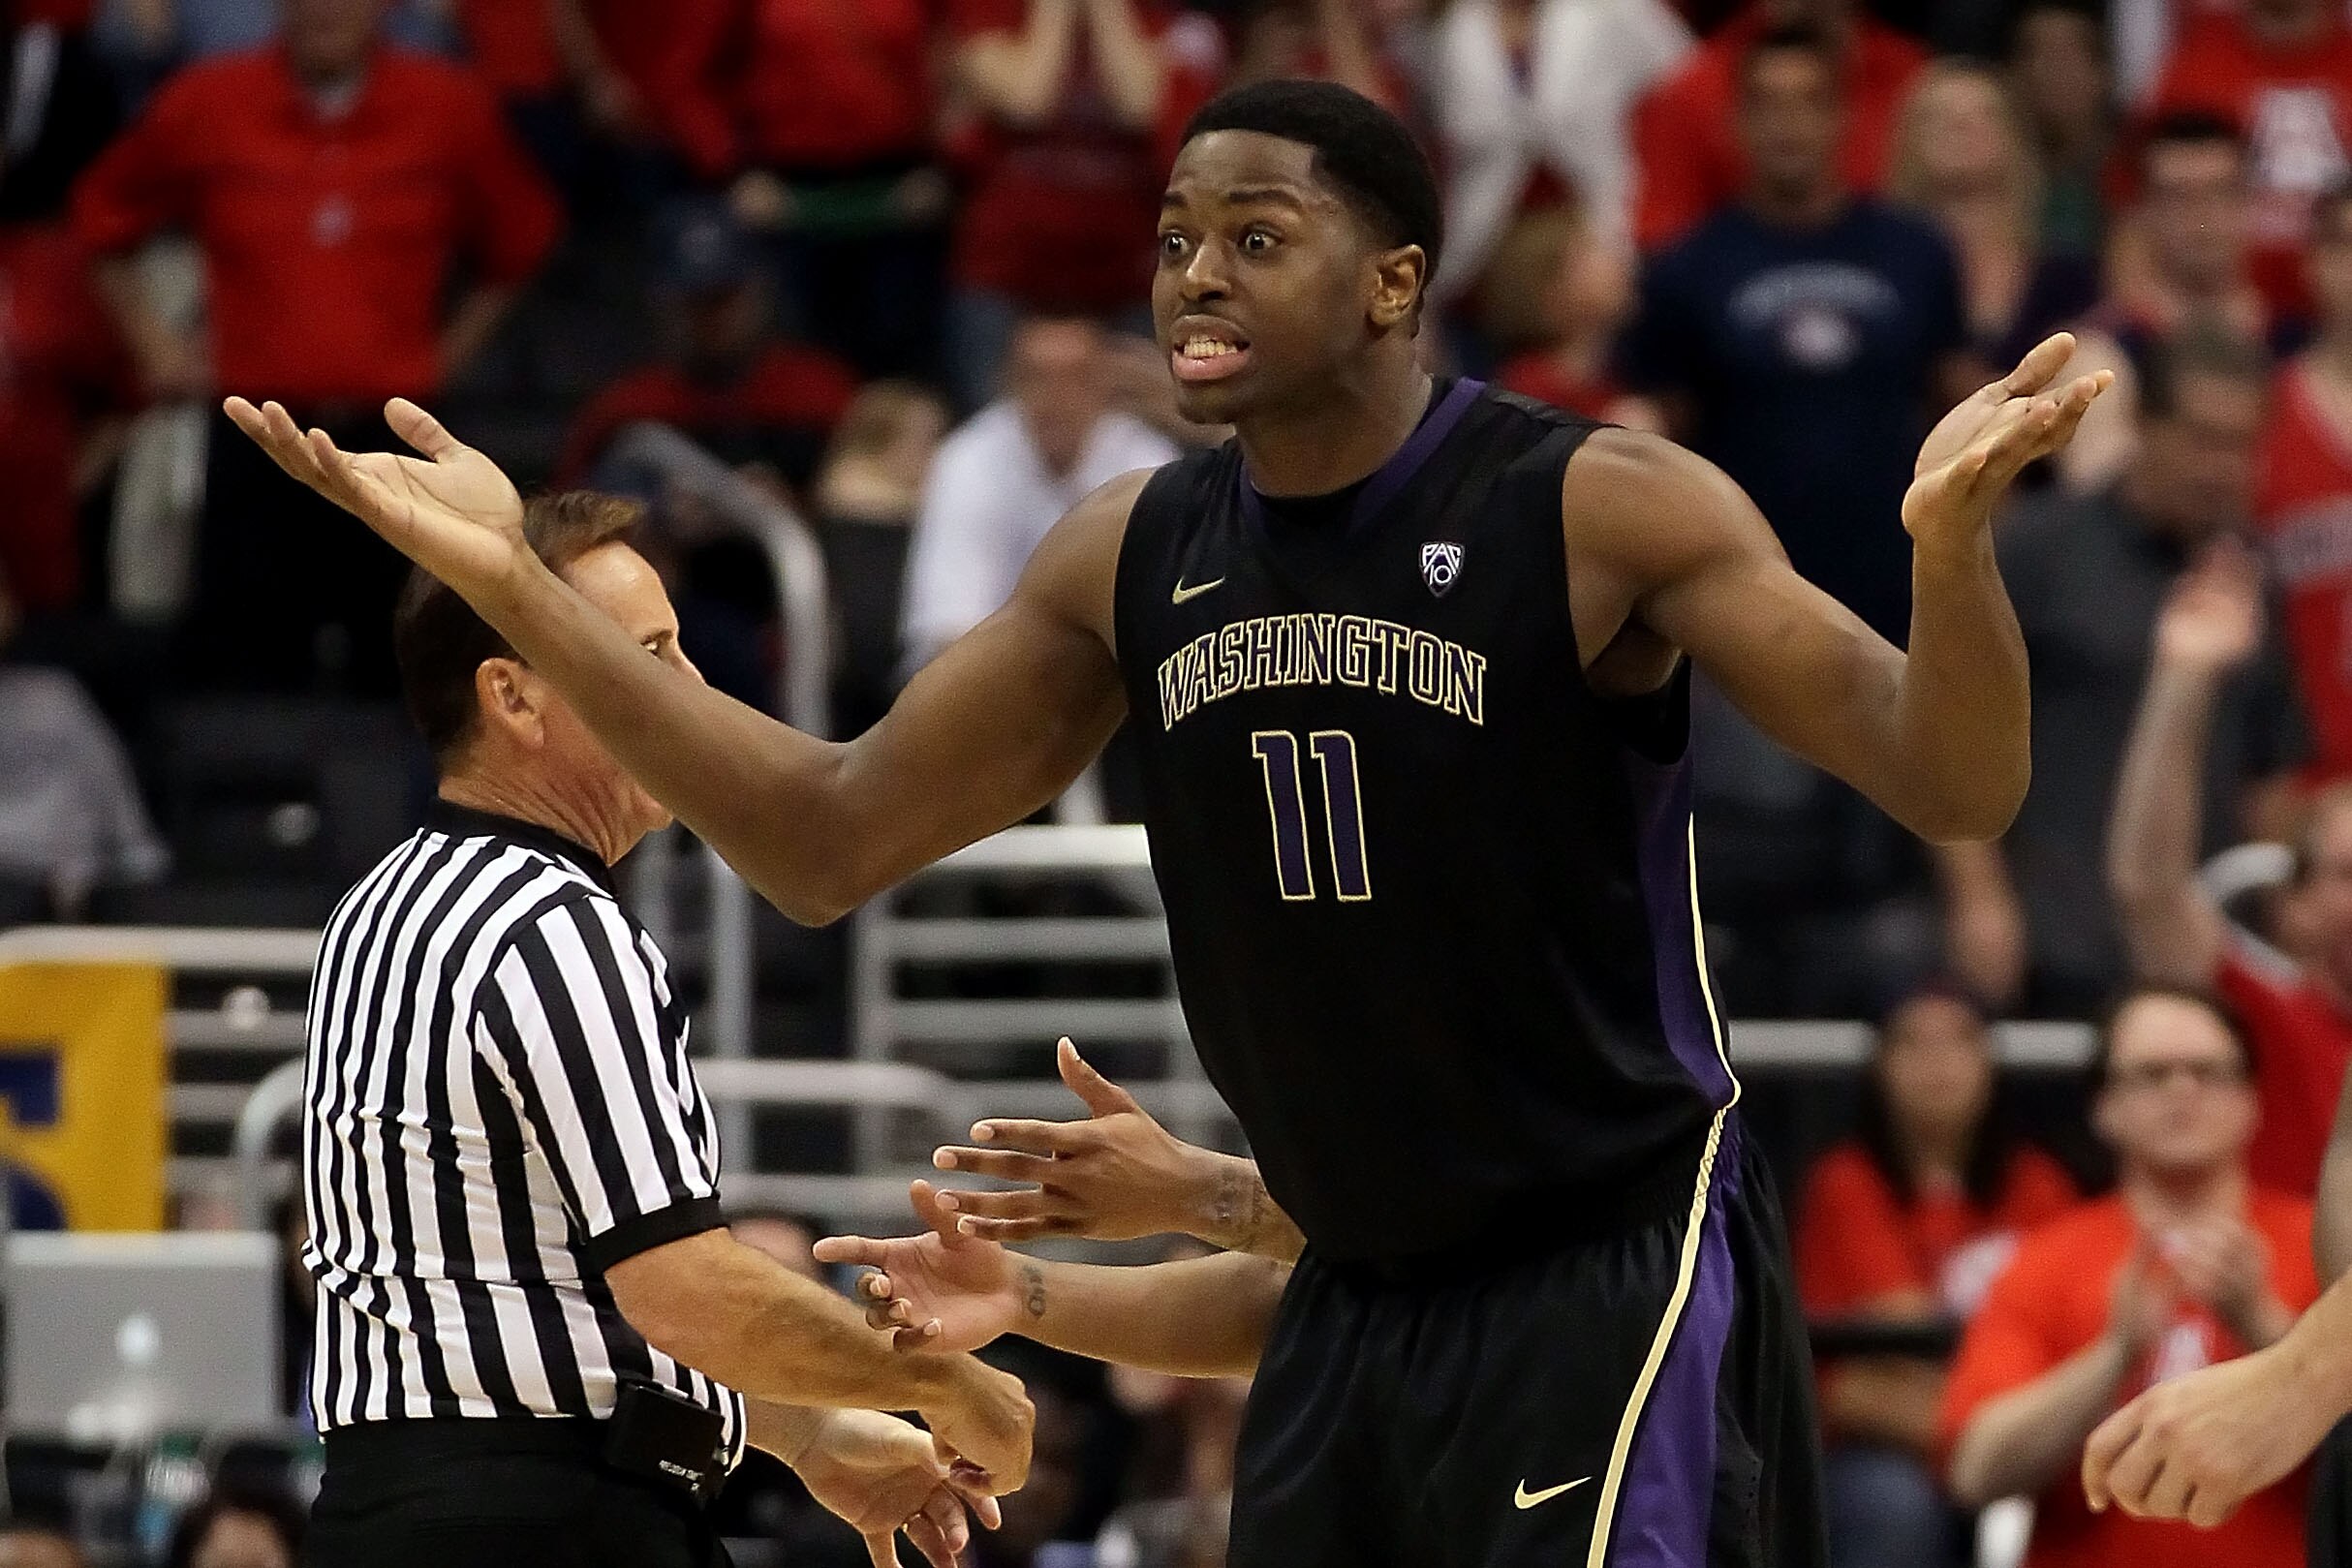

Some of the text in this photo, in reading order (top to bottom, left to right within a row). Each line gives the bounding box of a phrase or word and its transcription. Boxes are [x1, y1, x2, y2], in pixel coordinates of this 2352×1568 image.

[1422, 542, 1461, 574] PAC
[1158, 613, 1487, 730] WASHINGTON
[1252, 729, 1372, 902] 11
